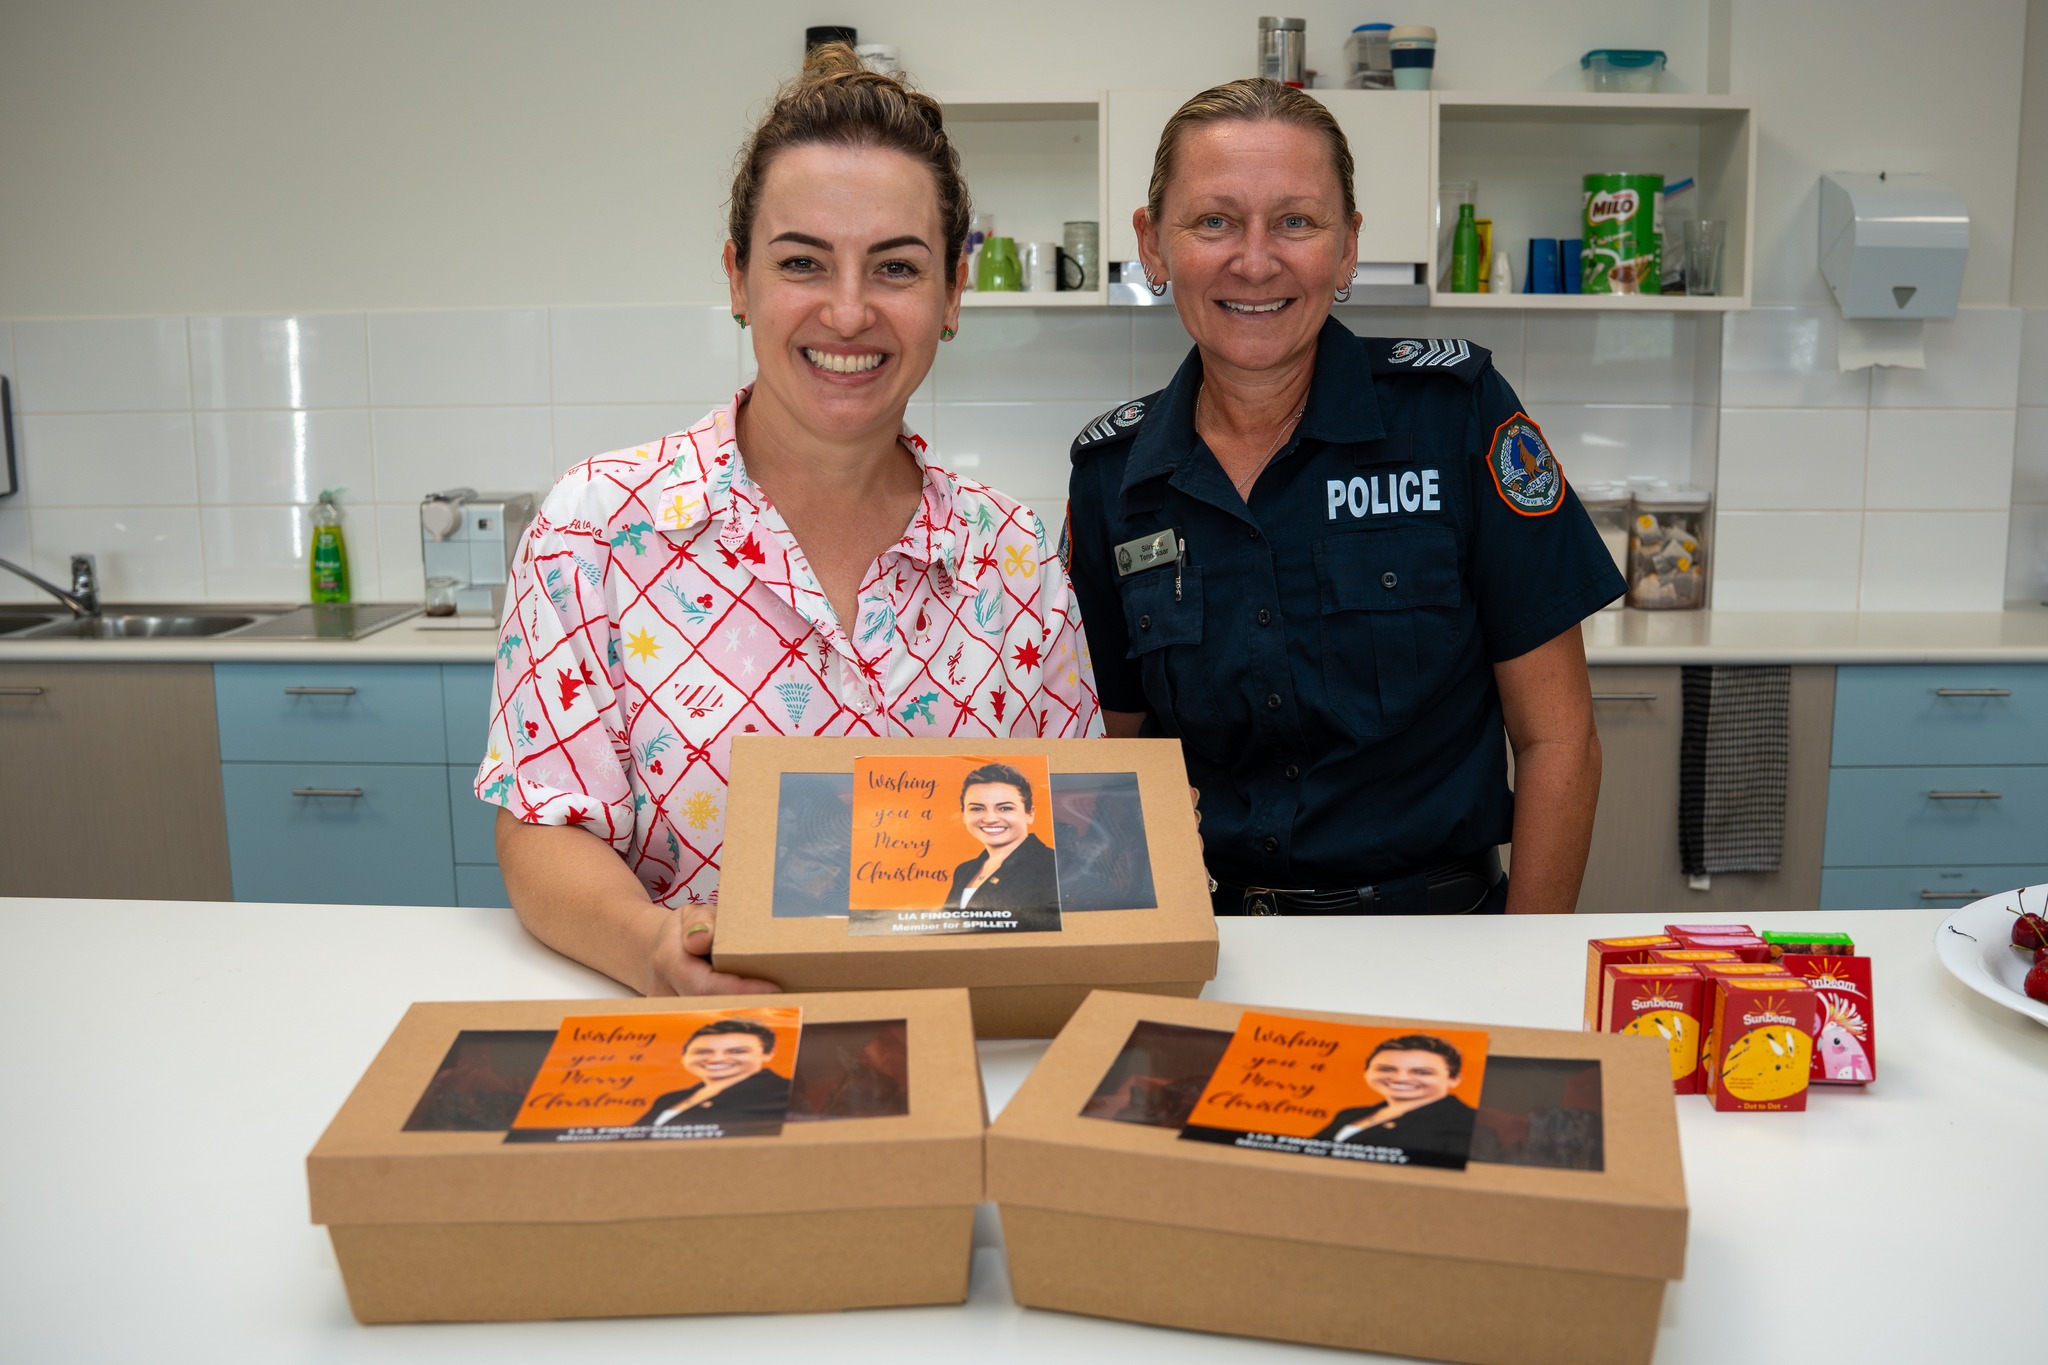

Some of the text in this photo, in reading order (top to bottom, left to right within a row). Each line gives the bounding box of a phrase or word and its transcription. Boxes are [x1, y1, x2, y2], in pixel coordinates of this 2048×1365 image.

[1593, 199, 1633, 218] MILO
[1526, 472, 1550, 492] POLICE
[1327, 469, 1440, 520] POLICE
[869, 770, 938, 800] Wishing
[872, 808, 932, 828] you a
[874, 831, 933, 858] Merry
[856, 861, 949, 884] Christmas
[892, 920, 1018, 932] Member for SPILLETT
[898, 910, 1012, 921] LIA FINOCCHIARO
[1803, 975, 1857, 991] unbeam
[1631, 998, 1684, 1011] Sunbeam
[1743, 1013, 1797, 1026] Sunbeam
[573, 1026, 657, 1049] Wishing
[1253, 1026, 1339, 1057] Wishing
[560, 1069, 635, 1091] Merry
[1240, 1072, 1315, 1099] Merry
[528, 1092, 647, 1110] Christmas
[1207, 1091, 1328, 1118] Christmas
